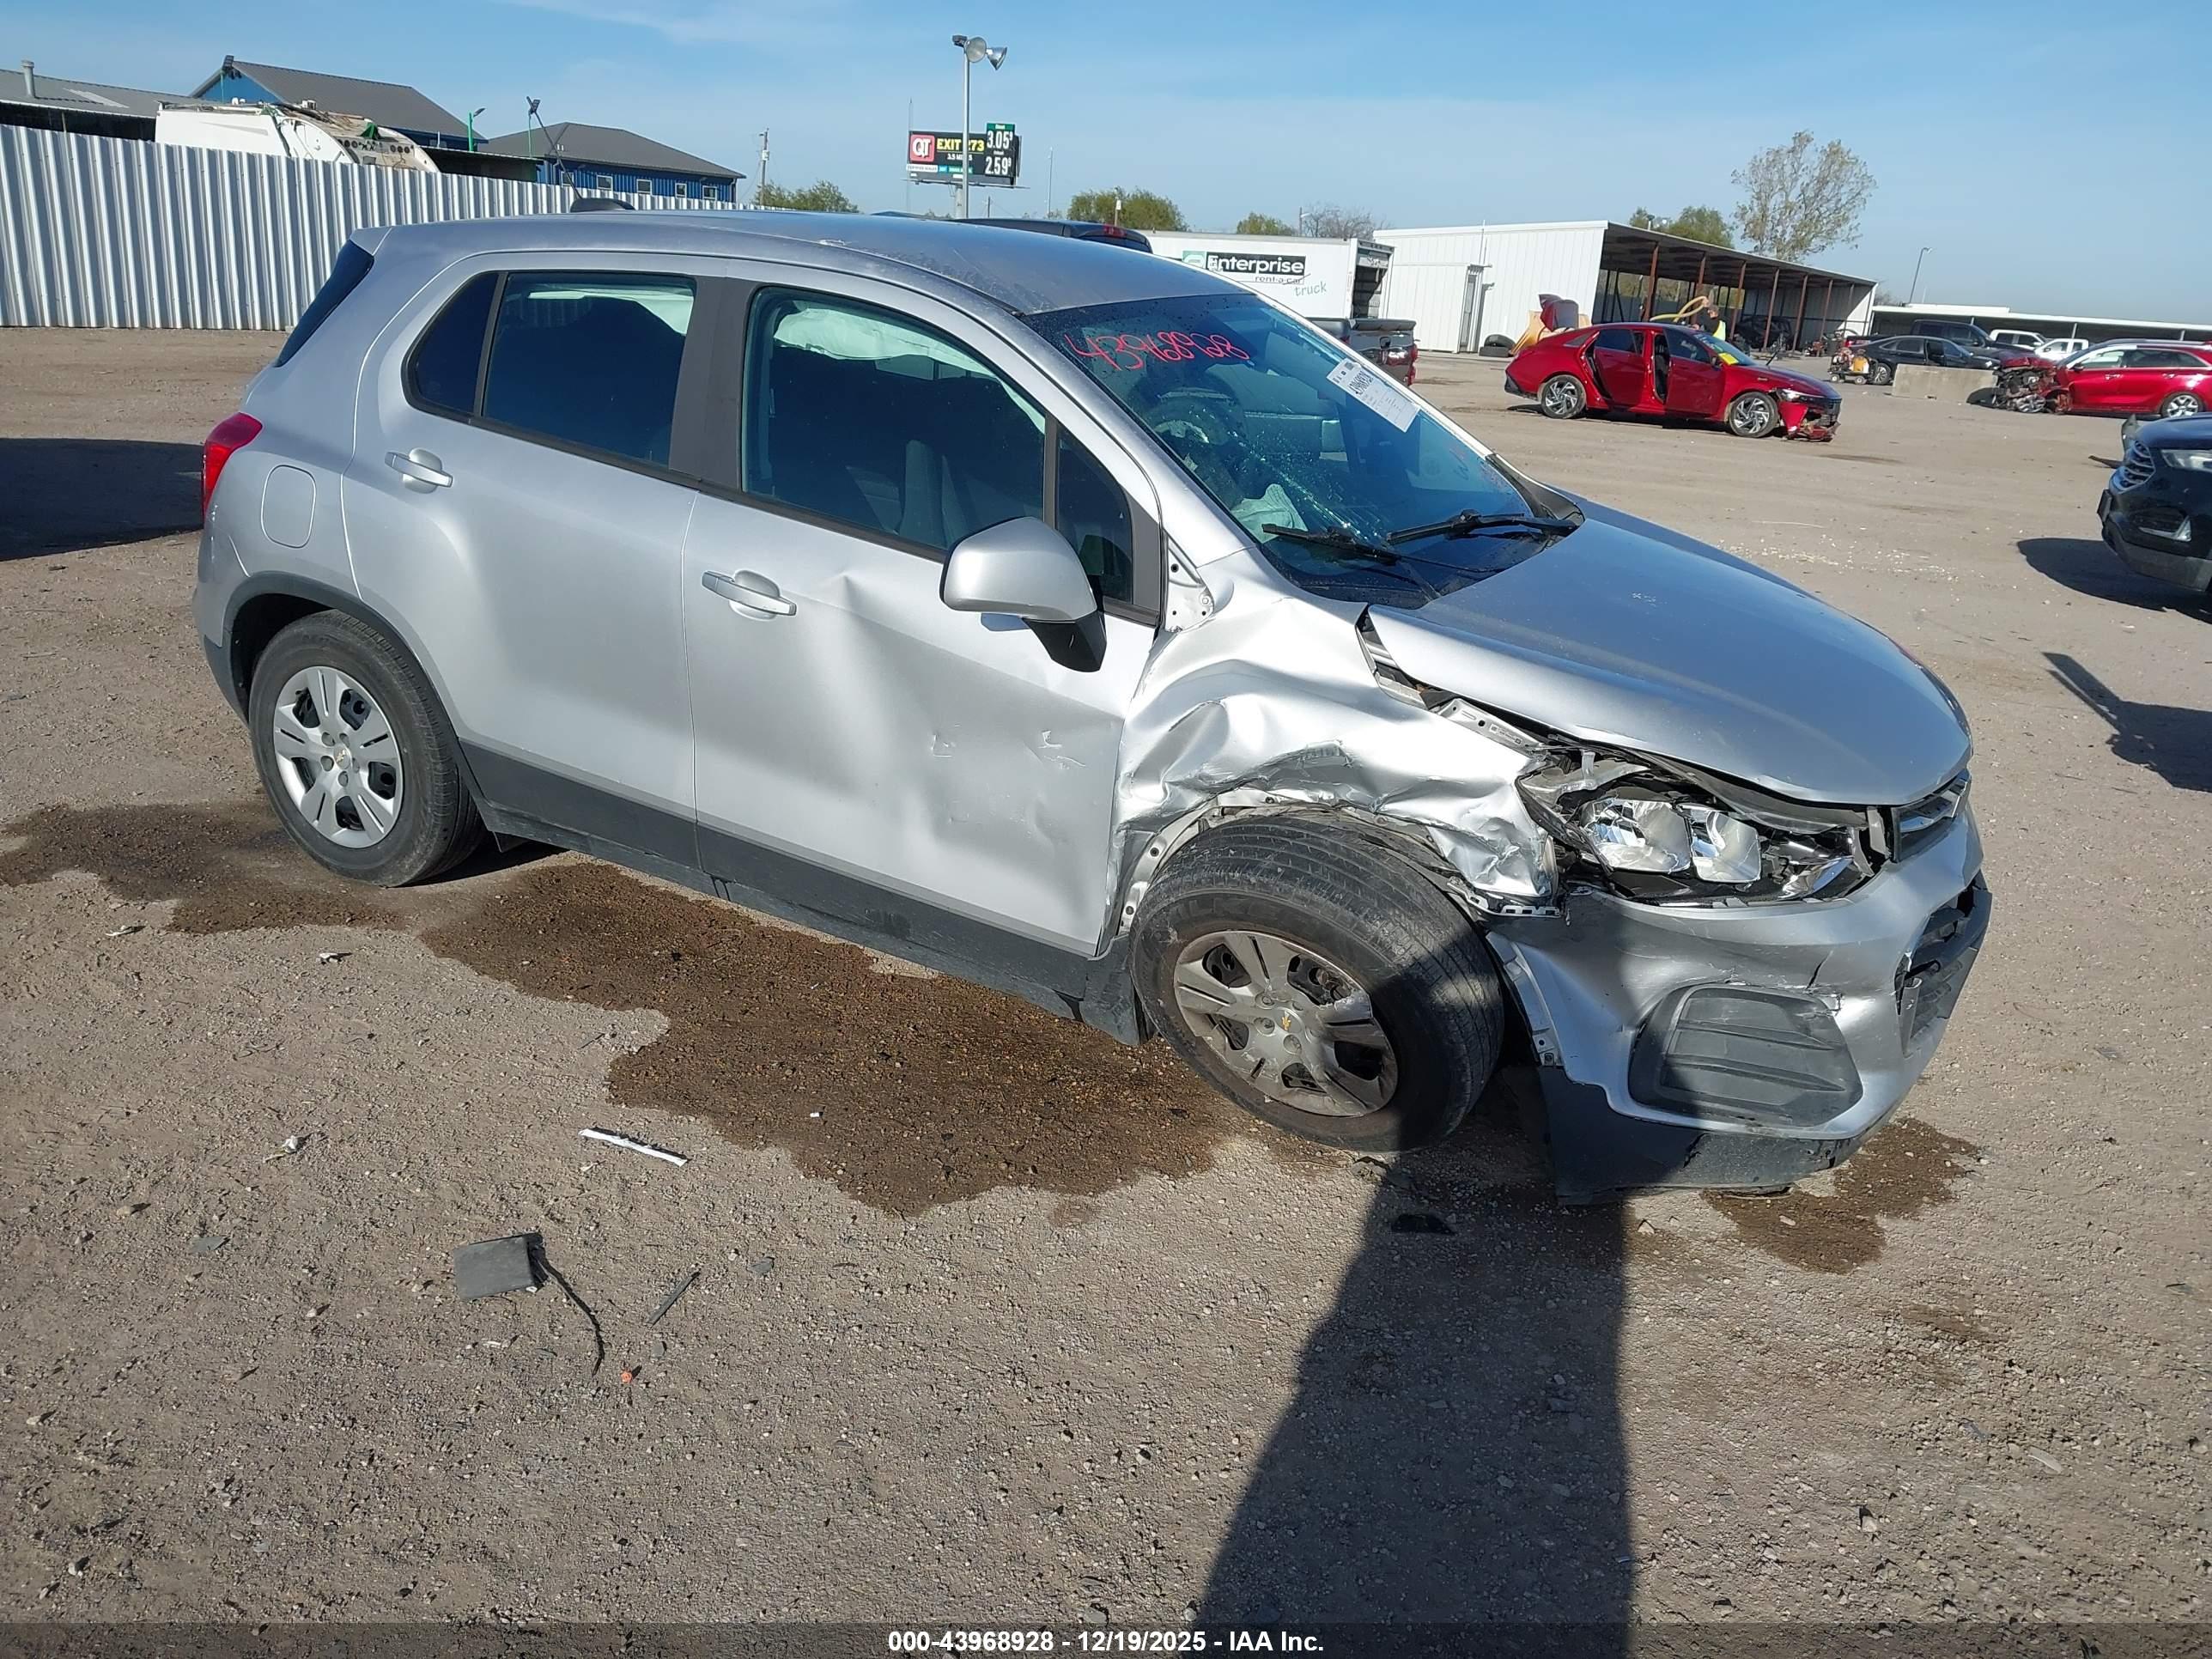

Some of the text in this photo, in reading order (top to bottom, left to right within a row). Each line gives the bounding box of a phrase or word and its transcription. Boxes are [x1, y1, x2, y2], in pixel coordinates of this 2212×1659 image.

[912, 137, 931, 157] QT
[937, 138, 985, 152] EXIT 73
[1294, 281, 1327, 296] truck
[1064, 330, 1250, 371] 43968928
